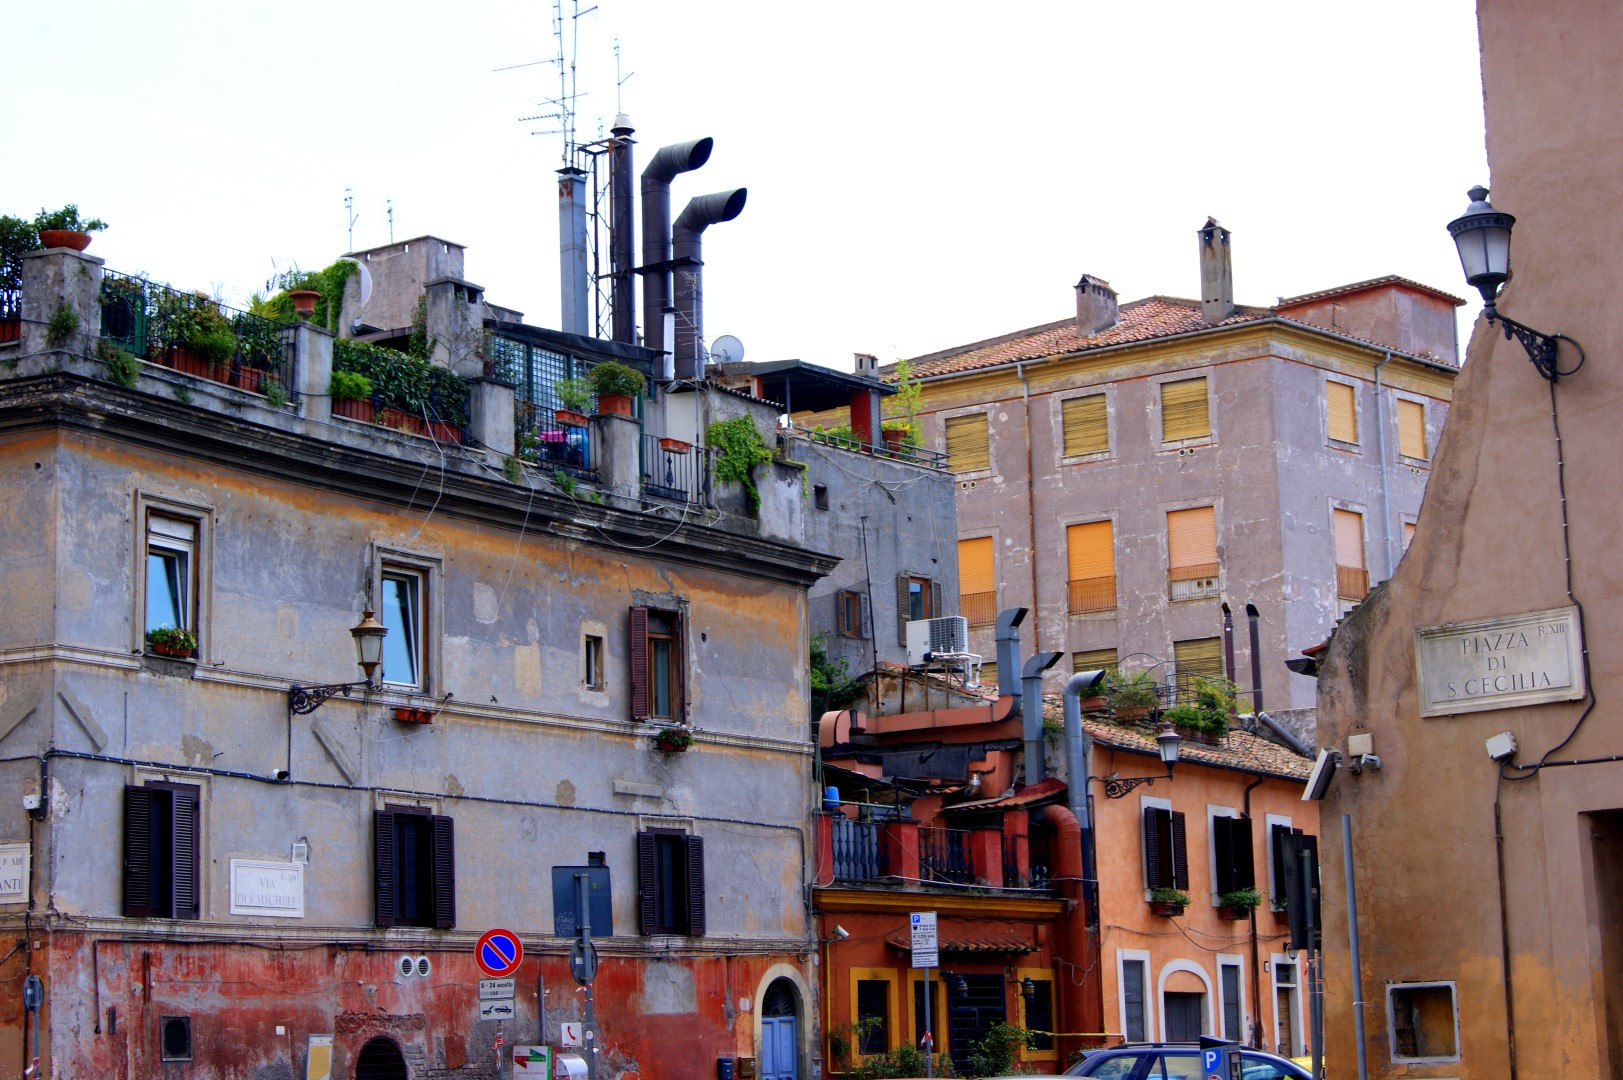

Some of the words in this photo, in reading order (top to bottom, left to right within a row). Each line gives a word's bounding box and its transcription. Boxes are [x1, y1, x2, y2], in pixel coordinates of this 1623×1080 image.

[1462, 631, 1529, 655] PIAZZA
[1488, 655, 1507, 671] DI
[1447, 681, 1460, 698] S.
[1465, 671, 1551, 696] CECILIA
[259, 877, 276, 889] VIA
[256, 894, 297, 907] MICHELE
[1205, 1051, 1217, 1069] P
